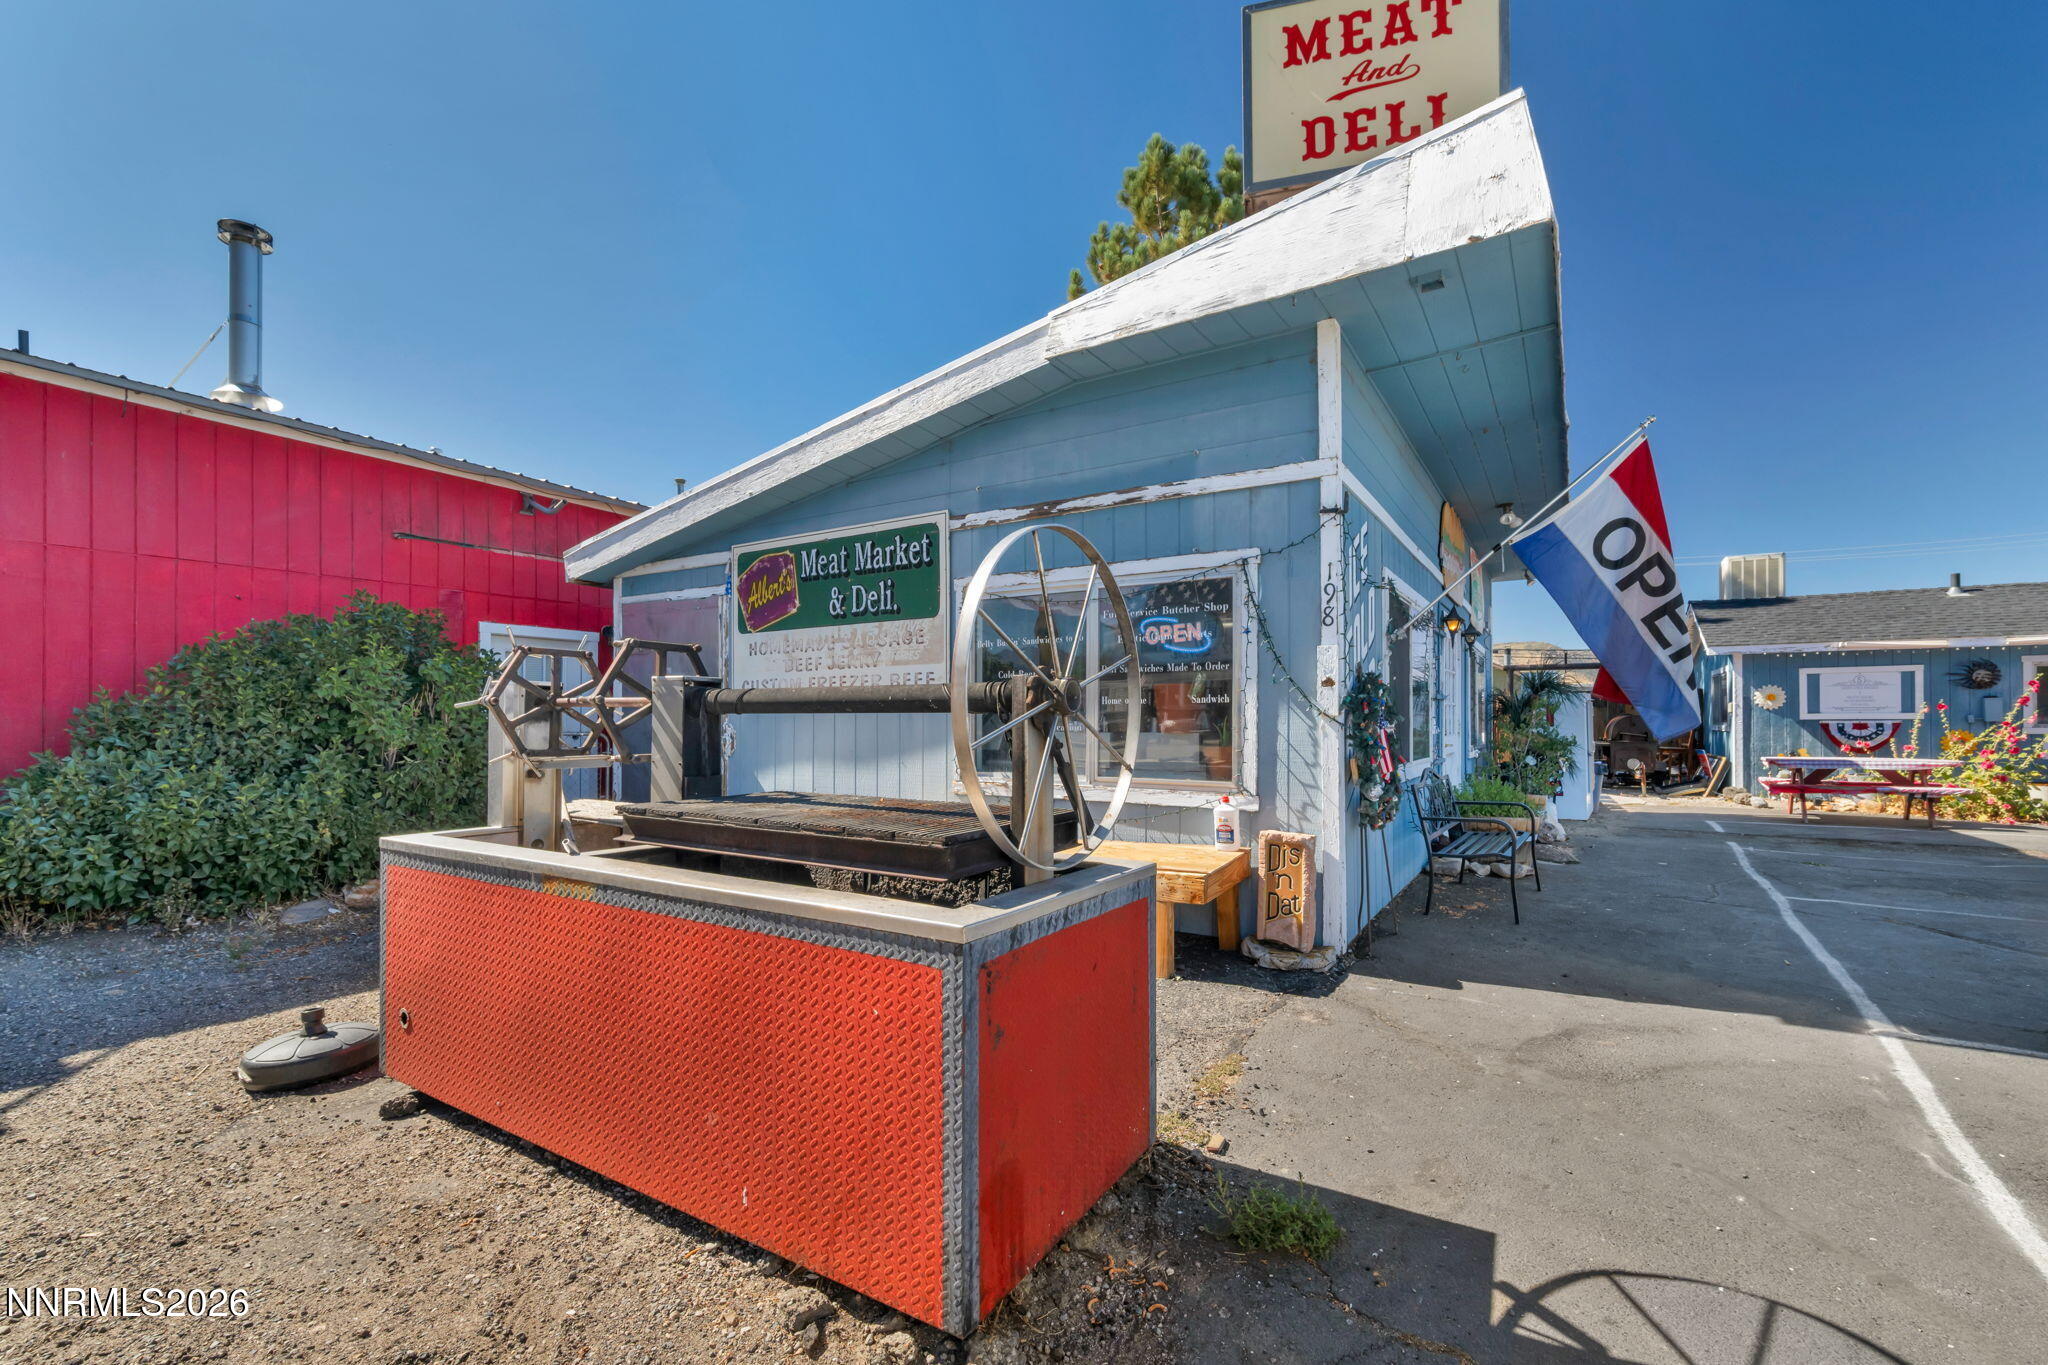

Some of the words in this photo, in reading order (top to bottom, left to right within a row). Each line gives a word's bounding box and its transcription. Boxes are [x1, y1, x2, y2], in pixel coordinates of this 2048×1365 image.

[1282, 0, 1462, 69] MEAT
[1341, 53, 1420, 88] And
[1301, 92, 1448, 162] DELI
[800, 545, 848, 579] Meat
[854, 533, 931, 572] Market
[748, 569, 793, 613] Albert's
[829, 587, 844, 616] &
[1128, 607, 1158, 617] ervice
[1162, 604, 1200, 615] Butcher
[1204, 602, 1229, 614] Shop
[977, 639, 993, 650] Belly
[1145, 621, 1202, 645] OPEN
[784, 656, 823, 673] BEEF
[1167, 662, 1188, 672] Made
[1191, 662, 1202, 671] To
[1205, 661, 1230, 671] Order
[1101, 696, 1122, 705] Home
[1191, 694, 1230, 704] Sandwich
[1268, 844, 1300, 873] Dis
[1266, 891, 1301, 921] Dat
